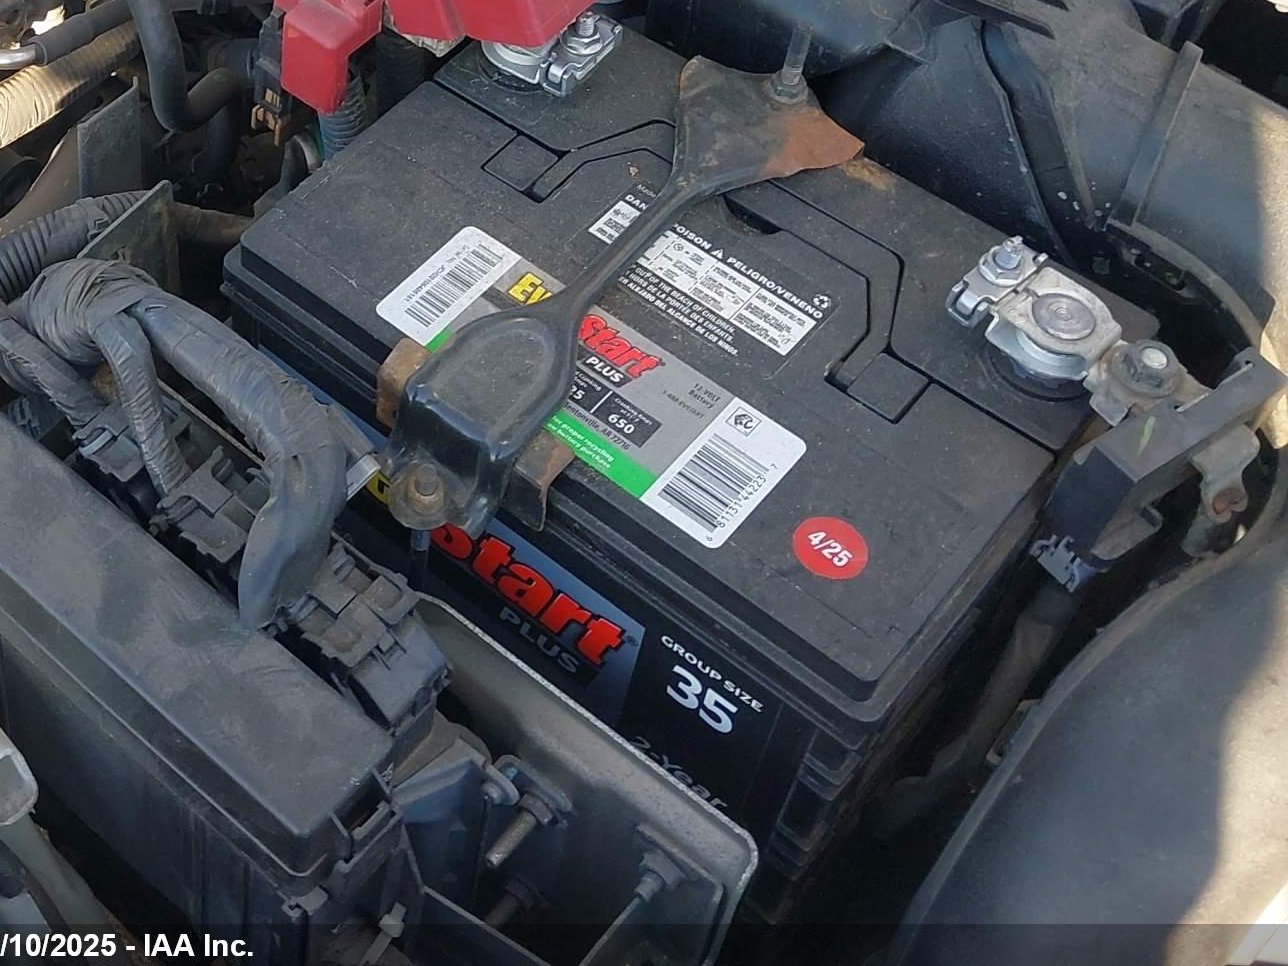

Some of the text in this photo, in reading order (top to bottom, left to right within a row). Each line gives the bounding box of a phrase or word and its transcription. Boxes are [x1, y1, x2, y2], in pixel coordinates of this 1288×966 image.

[657, 281, 671, 293] THE
[726, 257, 824, 319] PELIGRO/VENENO
[578, 314, 662, 378] Start
[586, 356, 624, 383] PLUS
[606, 411, 635, 435] 650
[716, 501, 744, 528] 81131
[743, 476, 768, 501] 44223
[808, 531, 853, 567] 4/25
[498, 608, 581, 674] PLUS
[661, 636, 764, 714] GROUP SIZE
[667, 665, 739, 734] 35
[632, 736, 728, 807] 2-Year
